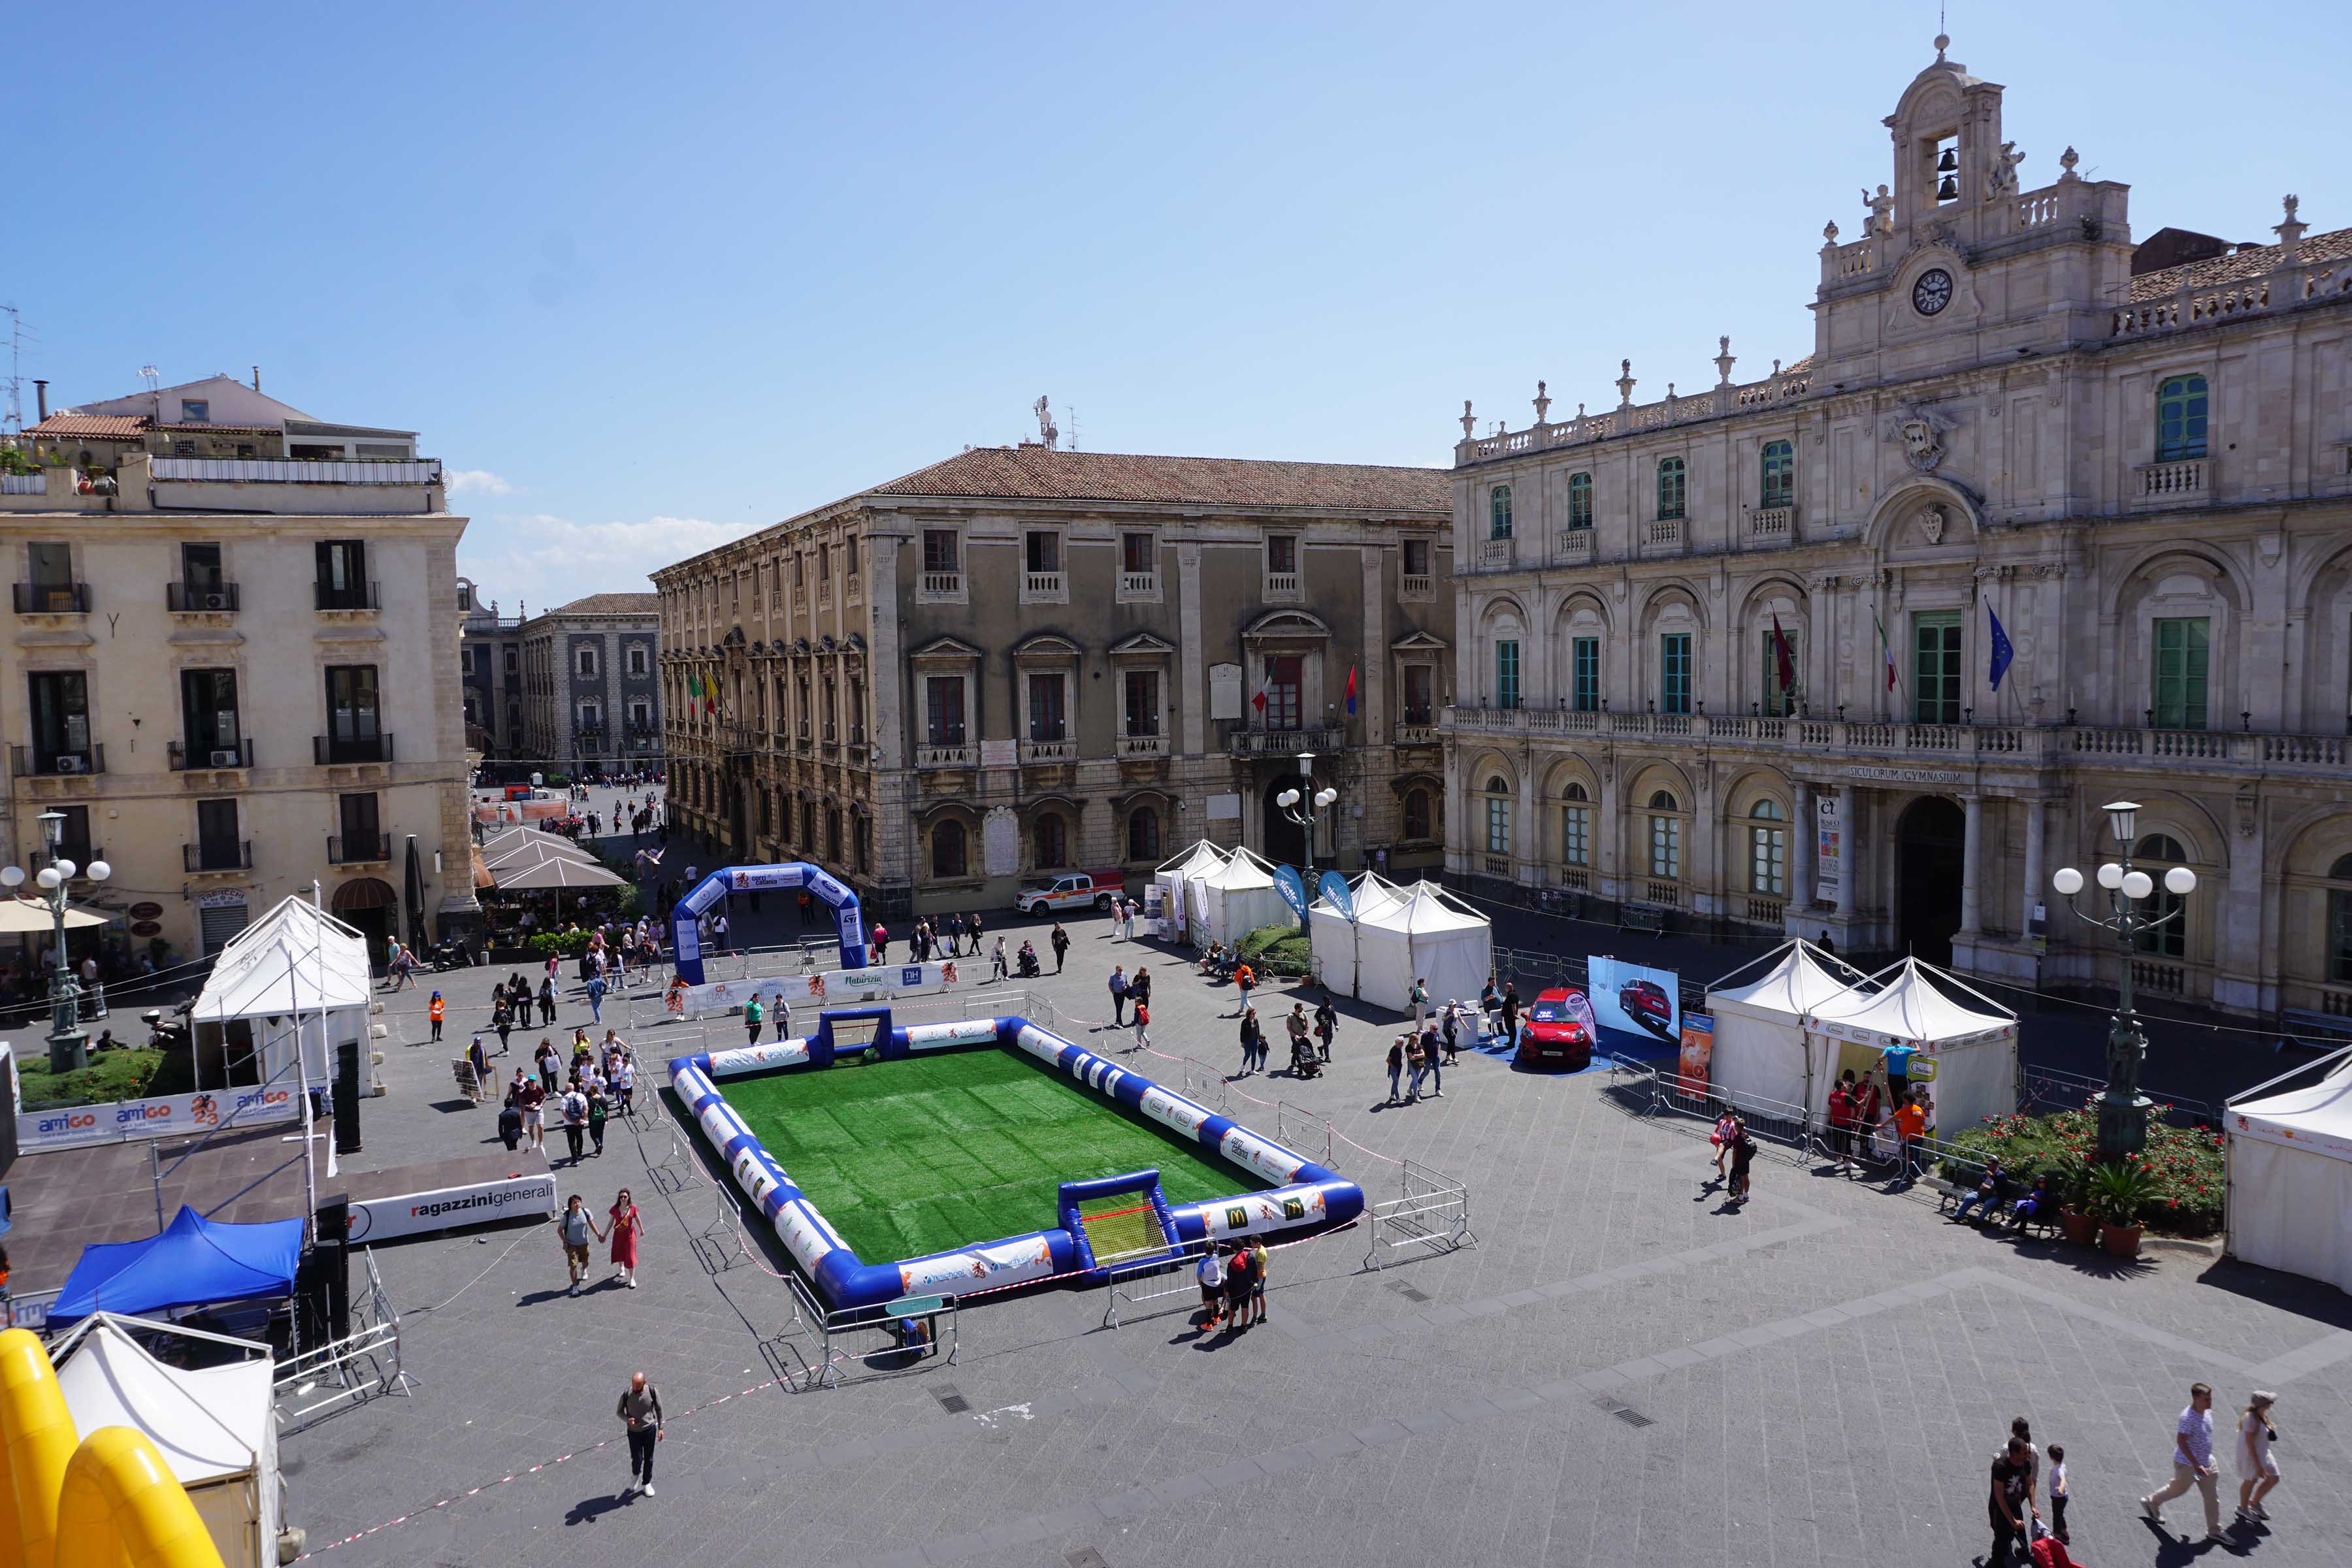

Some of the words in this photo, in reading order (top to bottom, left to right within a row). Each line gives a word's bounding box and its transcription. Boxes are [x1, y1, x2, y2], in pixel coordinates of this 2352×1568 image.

[1850, 767, 1899, 779] SICULORUM
[1904, 771, 1960, 783] GYMNASIUM
[116, 1104, 171, 1122] amiGO
[193, 1111, 219, 1125] 23
[39, 1113, 95, 1132] amiGO
[411, 1183, 553, 1217] ragazzinigenerali
